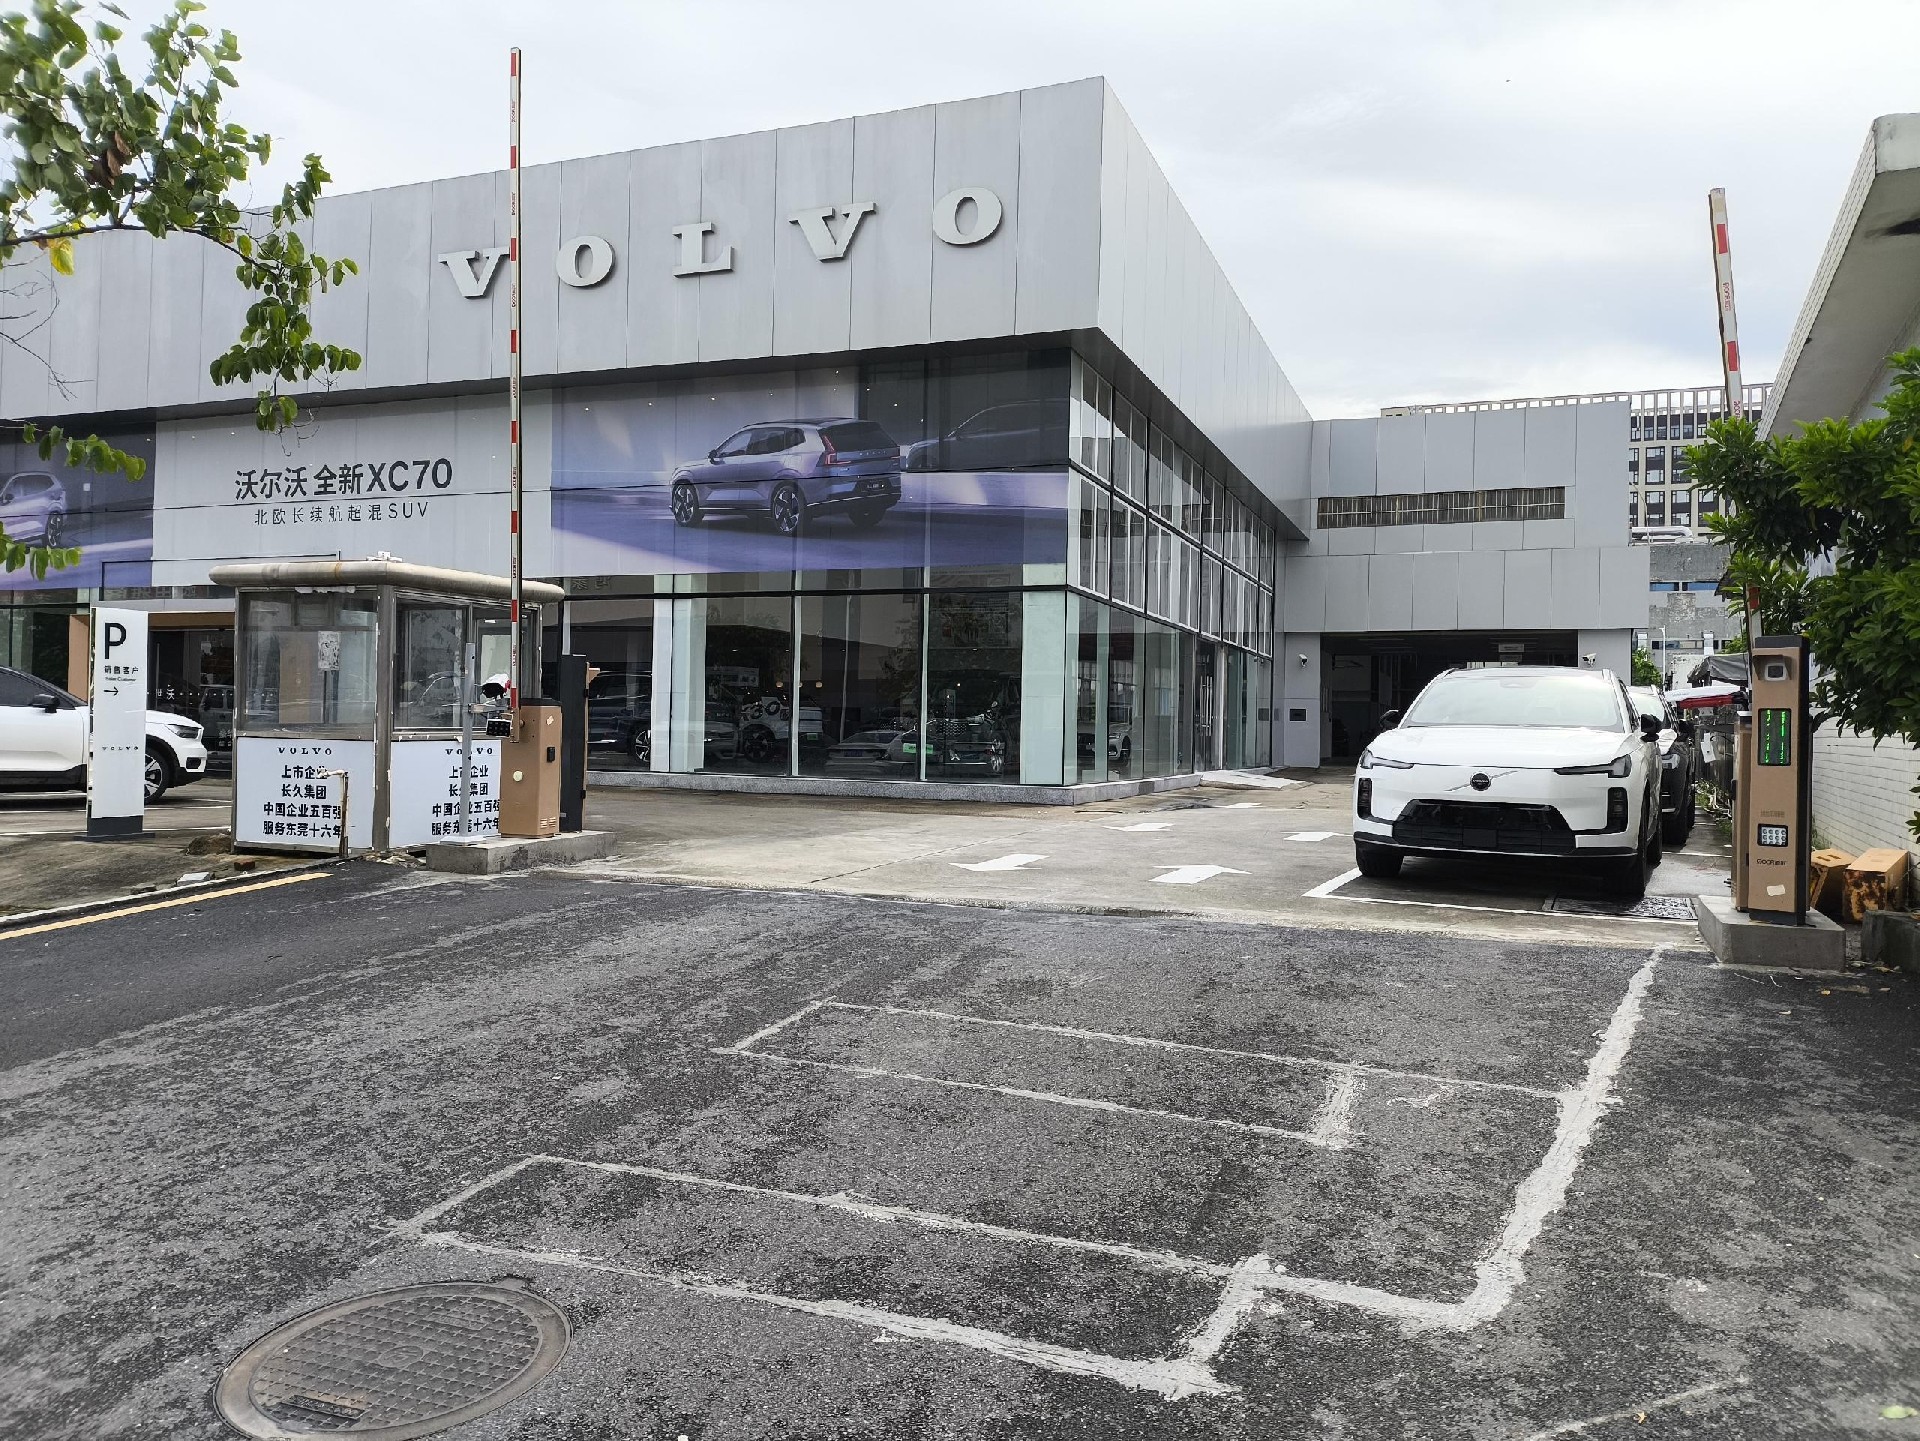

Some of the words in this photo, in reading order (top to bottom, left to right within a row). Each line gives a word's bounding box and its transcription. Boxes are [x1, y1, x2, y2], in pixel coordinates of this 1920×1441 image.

[438, 186, 1003, 299] VOLVO
[235, 457, 453, 501] 沃尔沃全新XC70
[254, 501, 429, 526] 北欧长续航超混SUV
[104, 622, 127, 660] P
[278, 747, 332, 756] VOLVO
[445, 747, 493, 755] VOVO
[281, 784, 327, 800] 长久集团
[448, 782, 489, 797] 长集团
[263, 801, 341, 820] 中国企业五百强
[263, 820, 341, 838] 服务东莞十六年
